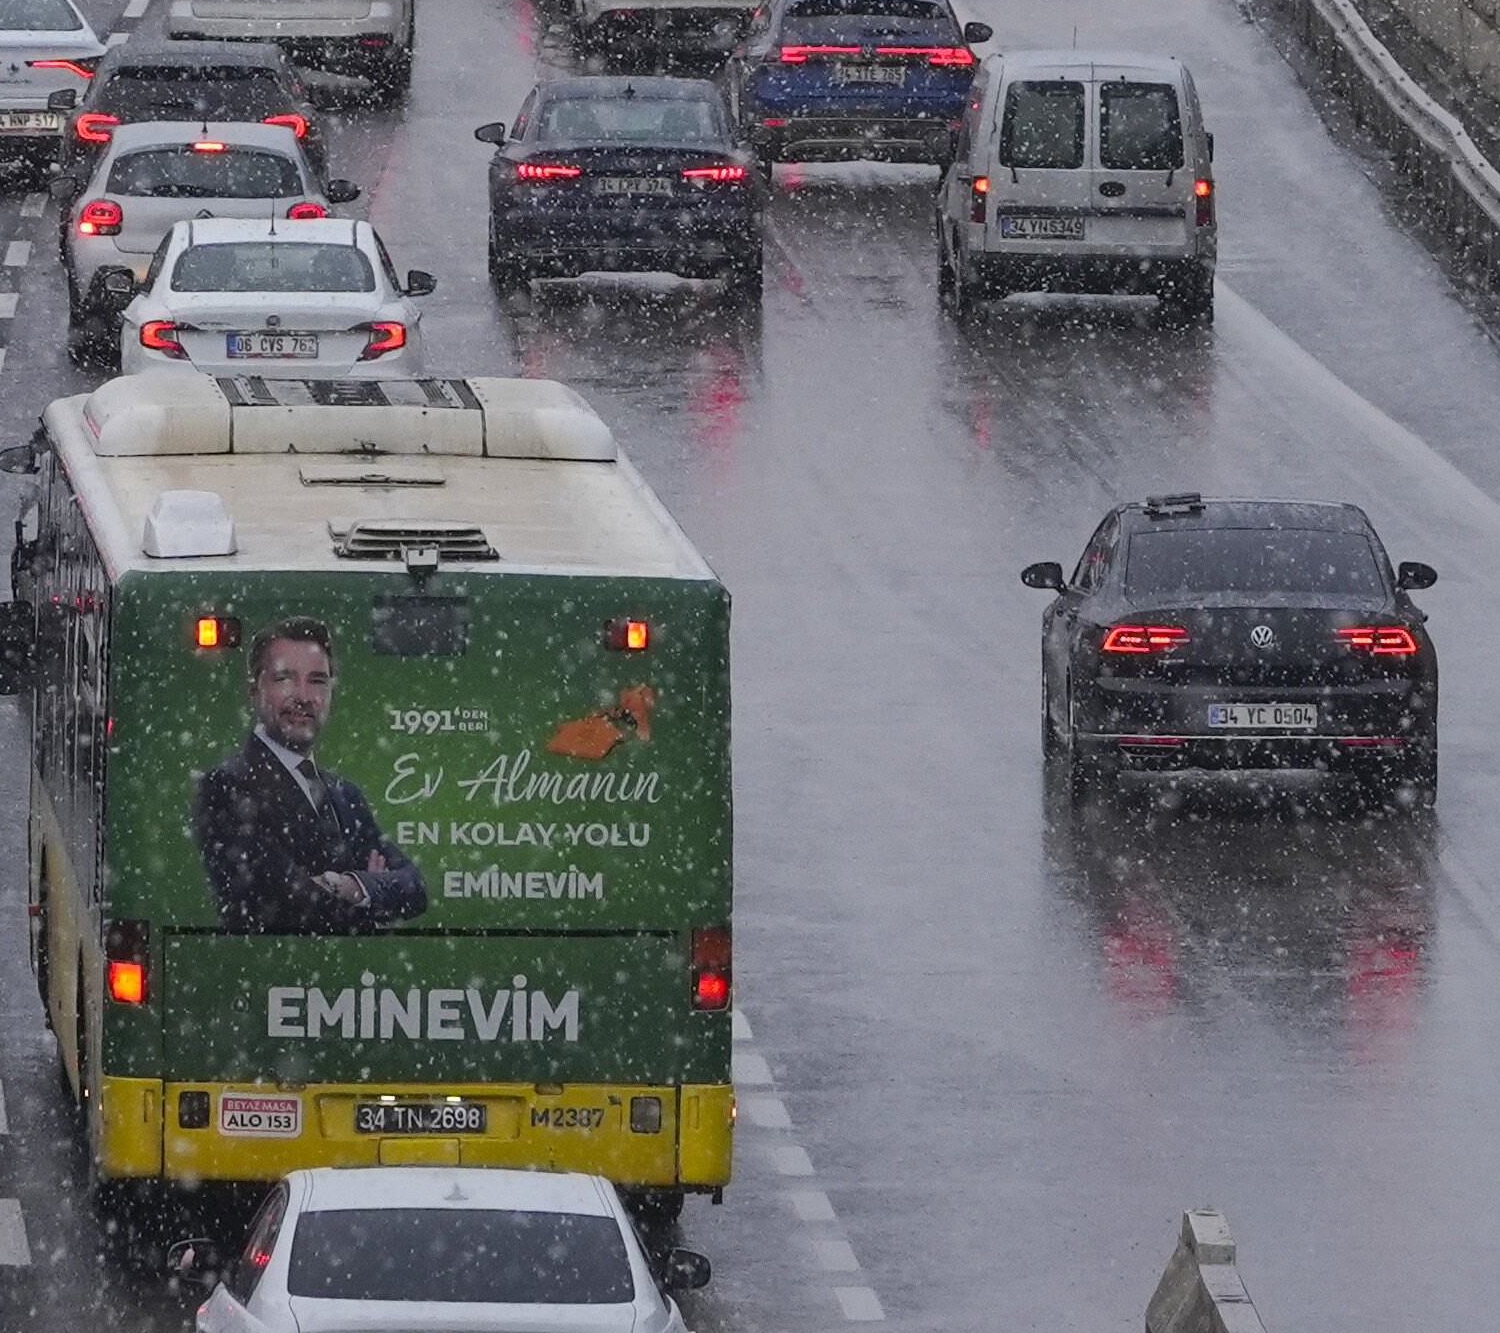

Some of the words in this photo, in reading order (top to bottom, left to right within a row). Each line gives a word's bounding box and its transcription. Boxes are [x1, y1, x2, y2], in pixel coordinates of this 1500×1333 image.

[1010, 220, 1025, 233] 34
[237, 337, 252, 352] 06
[260, 337, 284, 352] CVS
[1218, 708, 1238, 723] 34
[1247, 708, 1266, 724] YC
[1273, 708, 1312, 724] 0504
[385, 752, 443, 804] Ev
[457, 749, 661, 807] Almanın
[396, 821, 440, 845] EN
[451, 822, 556, 847] KOLAY
[565, 822, 651, 847] YOLU
[443, 864, 604, 900] EMİNEVİM
[267, 971, 579, 1042] EMİNEVİM
[227, 1100, 260, 1111] BEYAZ
[261, 1100, 293, 1112] MASA
[226, 1114, 262, 1128] ALO
[266, 1115, 291, 1128] 153
[360, 1109, 385, 1129] 34
[394, 1109, 423, 1129] TN
[430, 1109, 480, 1129] 2698
